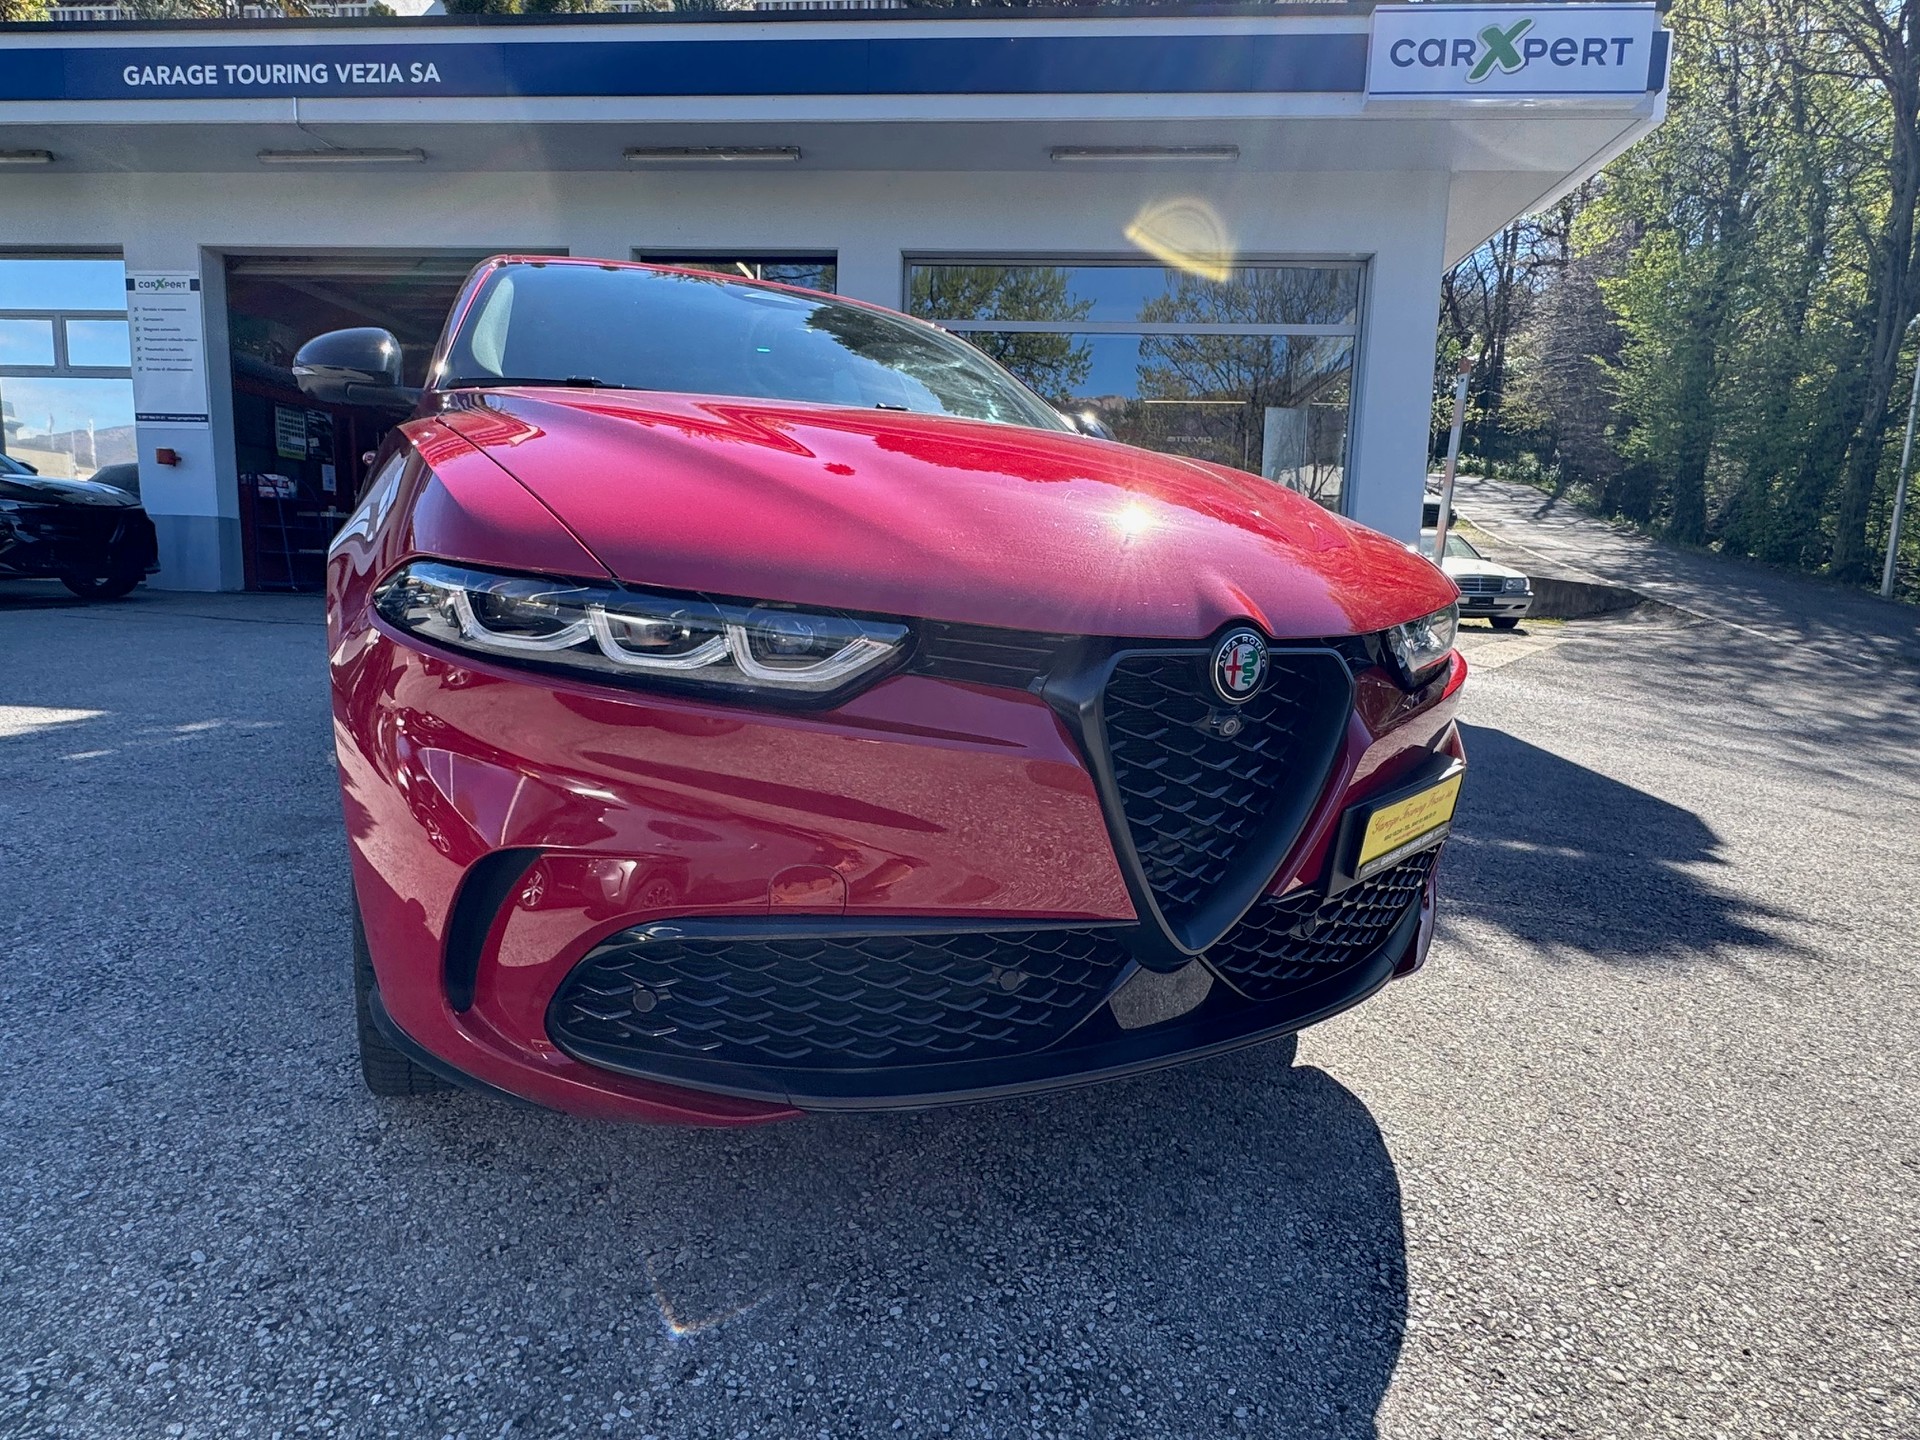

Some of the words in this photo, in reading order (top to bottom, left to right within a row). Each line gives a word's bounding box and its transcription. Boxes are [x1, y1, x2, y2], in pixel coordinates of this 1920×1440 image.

[123, 65, 218, 86] GARAGE
[223, 64, 329, 85] TOURING
[334, 63, 404, 84] VEZIA
[410, 62, 441, 83] SA
[1219, 640, 1238, 668] ALFA
[1242, 636, 1267, 668] ROMEO
